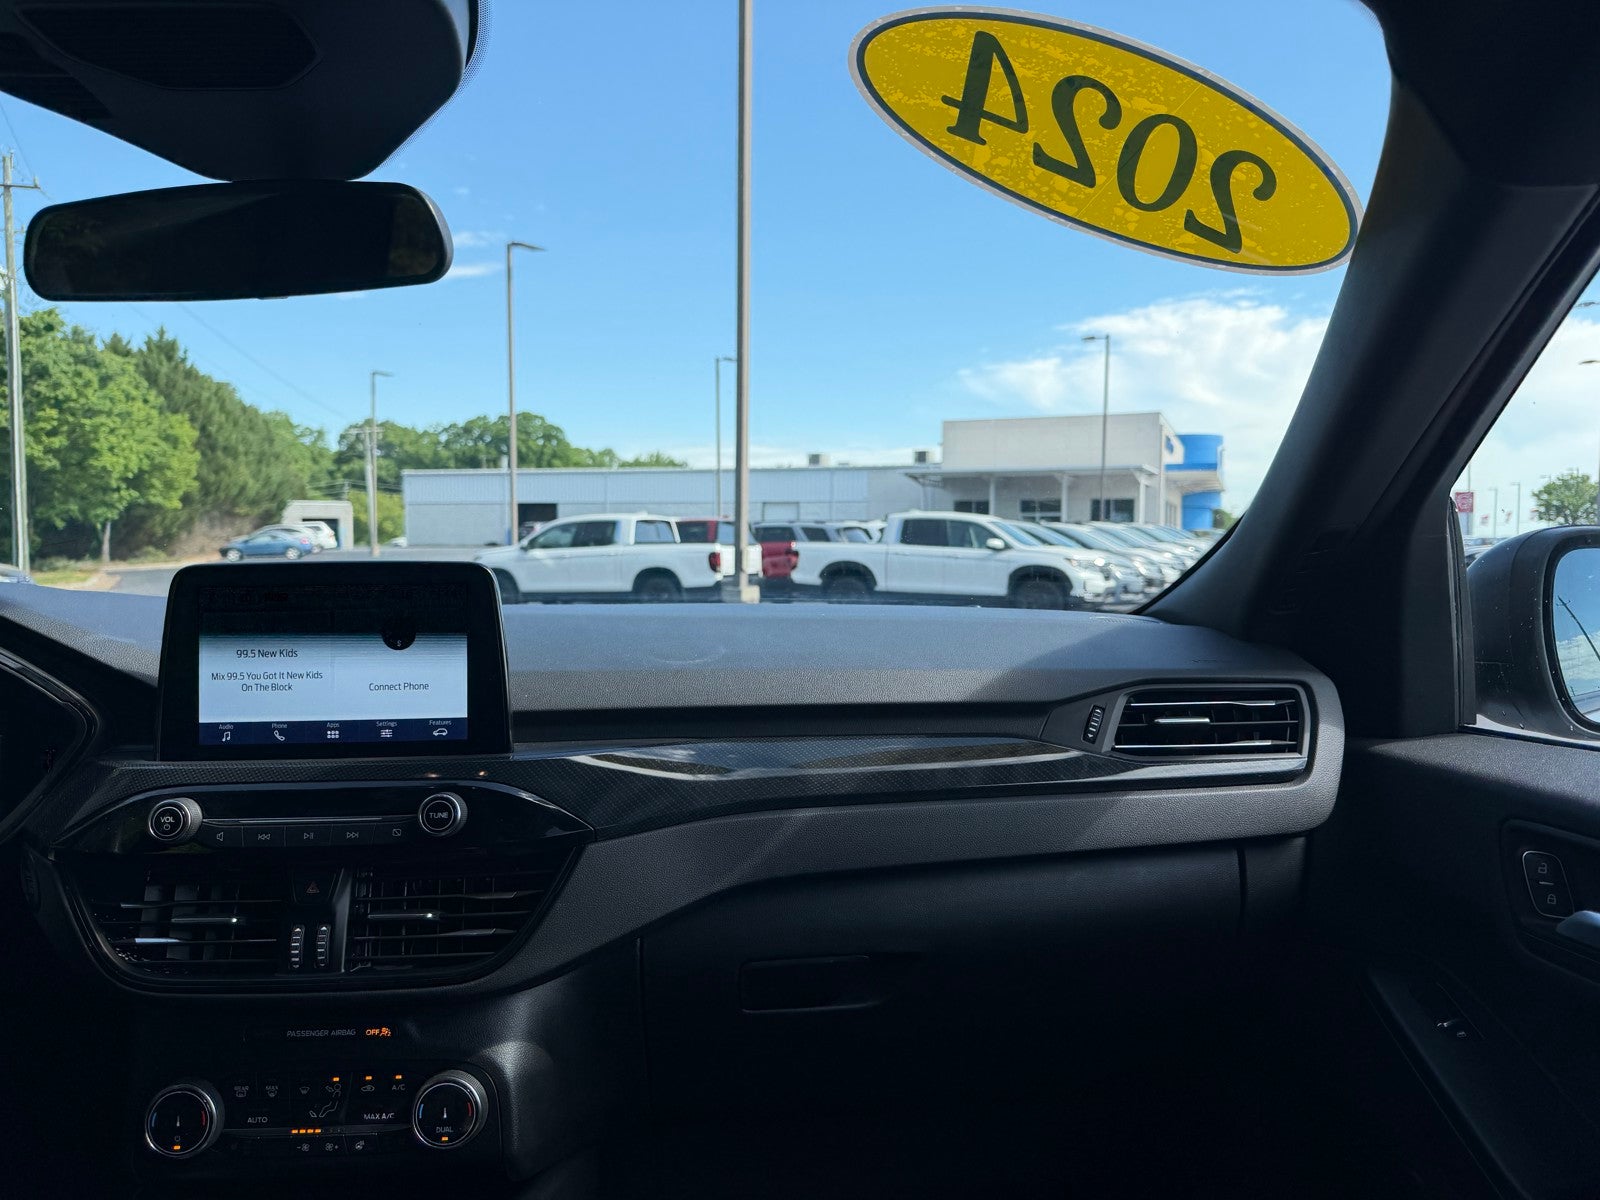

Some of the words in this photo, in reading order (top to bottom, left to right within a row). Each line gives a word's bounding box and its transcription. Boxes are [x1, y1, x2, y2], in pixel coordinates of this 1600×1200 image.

[236, 649, 256, 658] 99.5
[257, 649, 277, 658] New
[279, 648, 299, 658] Kids
[211, 672, 225, 680] Mix
[226, 672, 245, 680] 99.5
[246, 672, 261, 680] You
[262, 671, 277, 680] Got
[278, 671, 285, 679] It
[286, 671, 304, 679] New
[305, 670, 323, 679] Kids
[241, 683, 253, 691] On
[254, 682, 270, 691] The
[270, 682, 293, 691] Block
[368, 682, 402, 691] Connect
[403, 681, 430, 690] Phone
[376, 720, 398, 728] Settings
[286, 1029, 329, 1037] PASSENGER
[330, 1028, 357, 1036] AIRBAG
[365, 1028, 380, 1036] OFF
[391, 1083, 406, 1091] A/C
[363, 1112, 380, 1120] MAX
